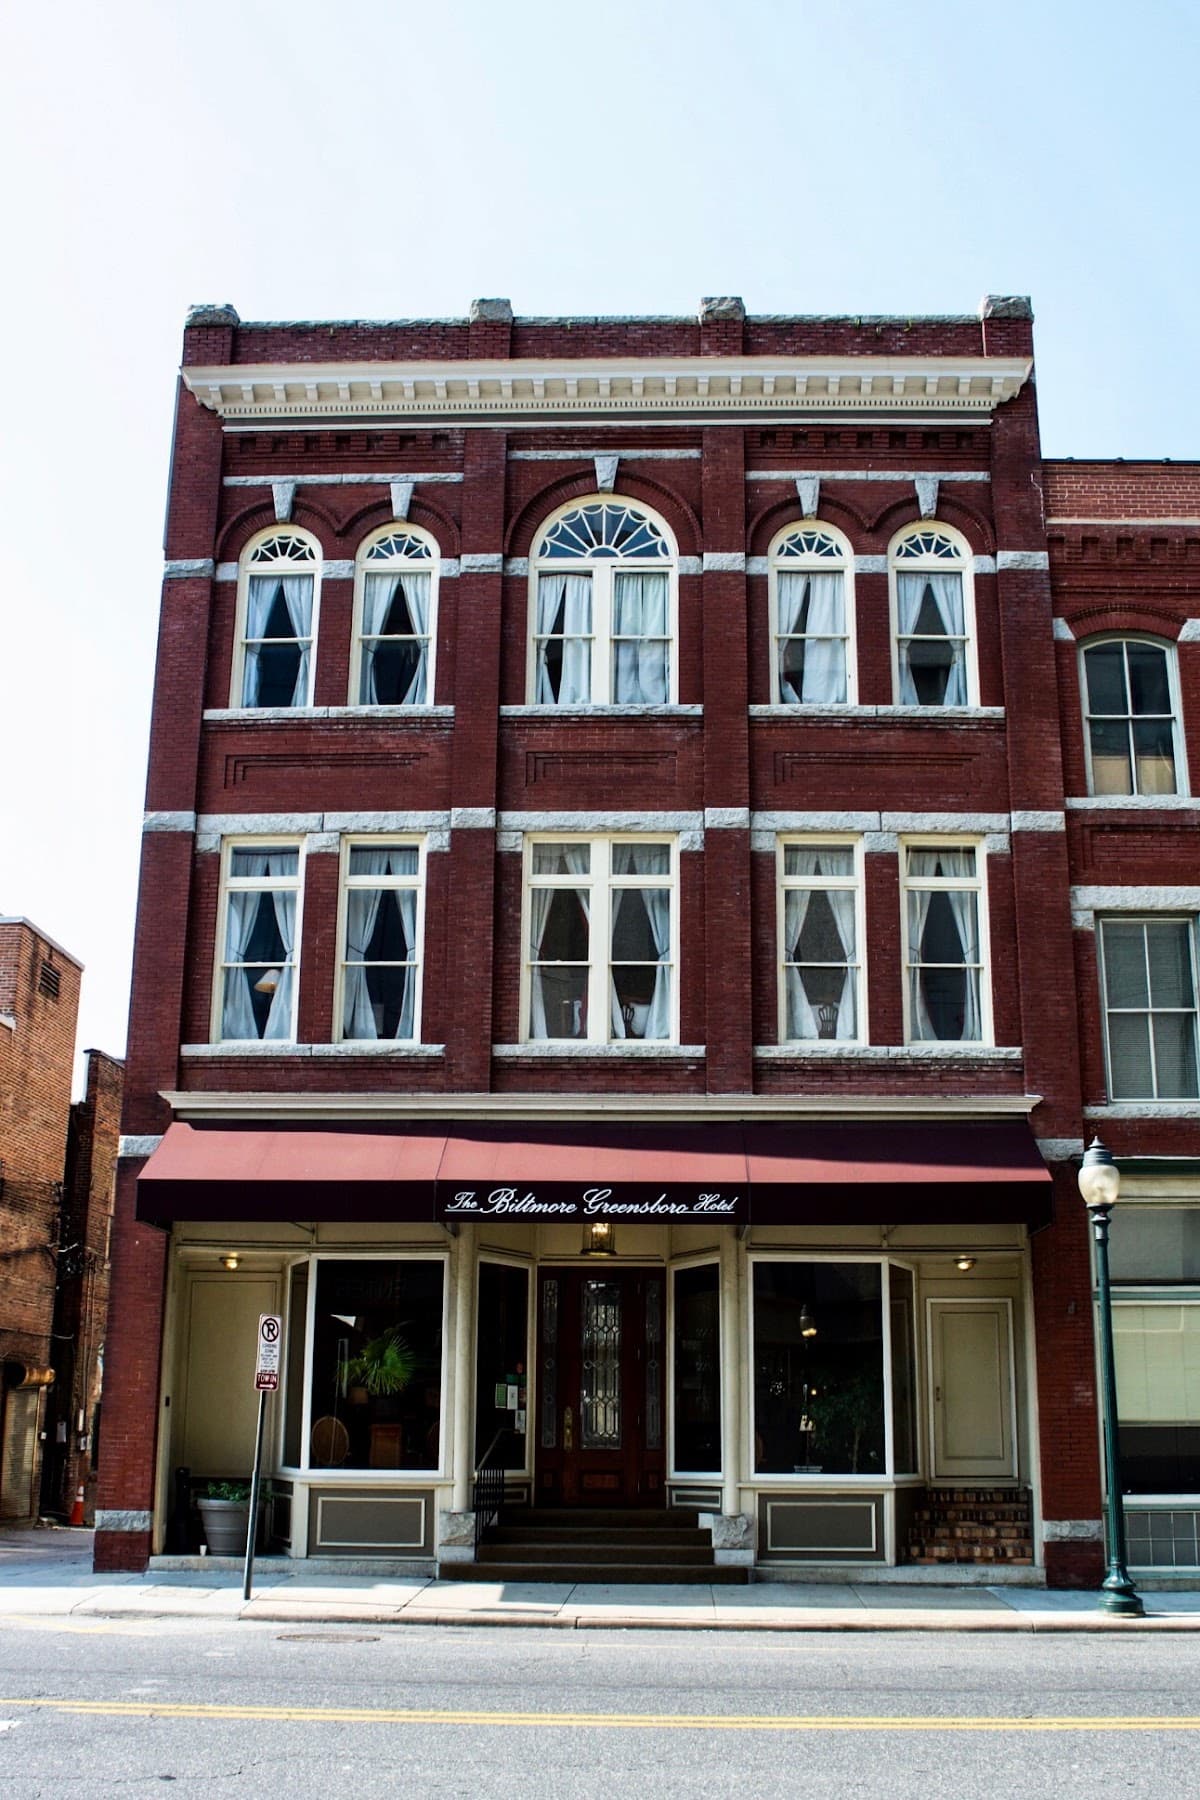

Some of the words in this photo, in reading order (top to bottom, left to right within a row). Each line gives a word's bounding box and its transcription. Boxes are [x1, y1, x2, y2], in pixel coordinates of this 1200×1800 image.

[447, 1191, 479, 1210] The
[480, 1187, 578, 1214] Biltmore
[583, 1188, 689, 1214] Greensboro
[692, 1193, 739, 1212] Hotel
